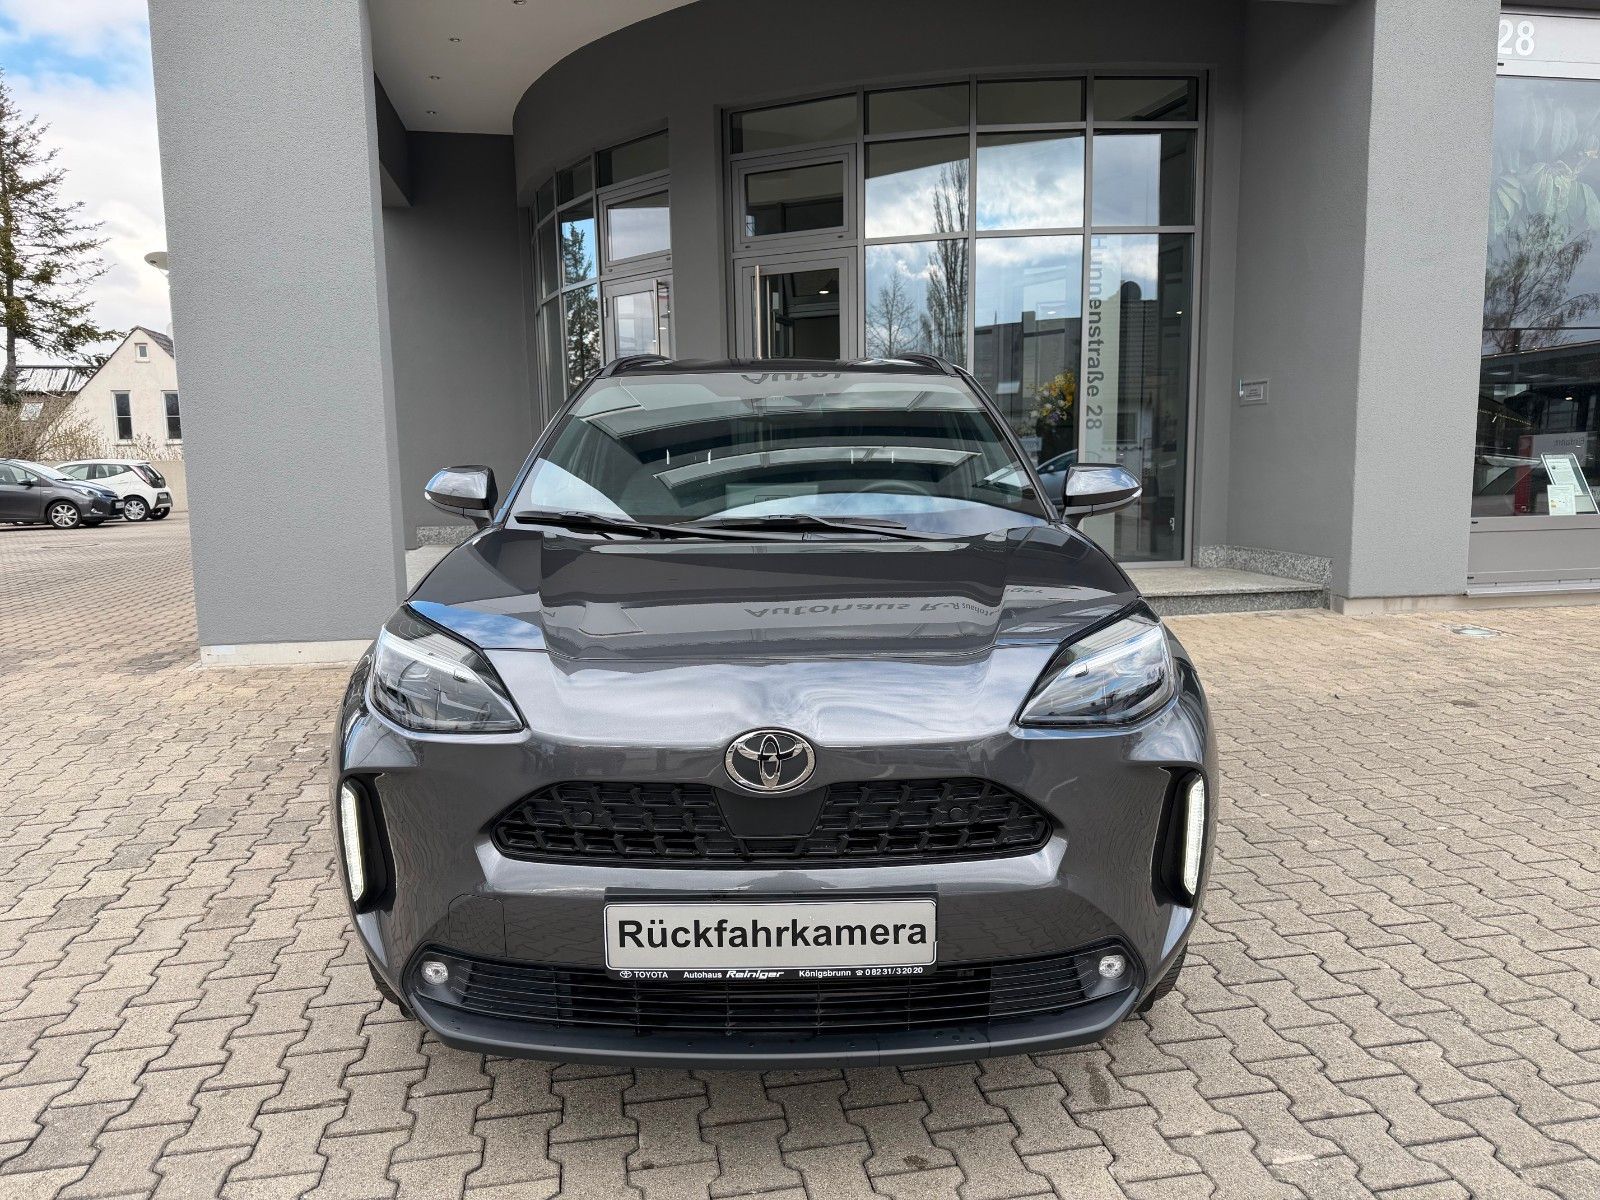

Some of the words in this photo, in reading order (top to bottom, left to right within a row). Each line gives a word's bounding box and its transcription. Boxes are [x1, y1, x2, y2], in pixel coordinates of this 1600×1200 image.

[1497, 19, 1535, 56] 28
[1086, 405, 1103, 429] 28
[618, 918, 927, 949] Rückfahrkamera
[634, 971, 669, 979] TOYOTA
[683, 971, 722, 979] Autohaus
[726, 970, 785, 980] Reiniger
[799, 969, 851, 979] Königsbrunn
